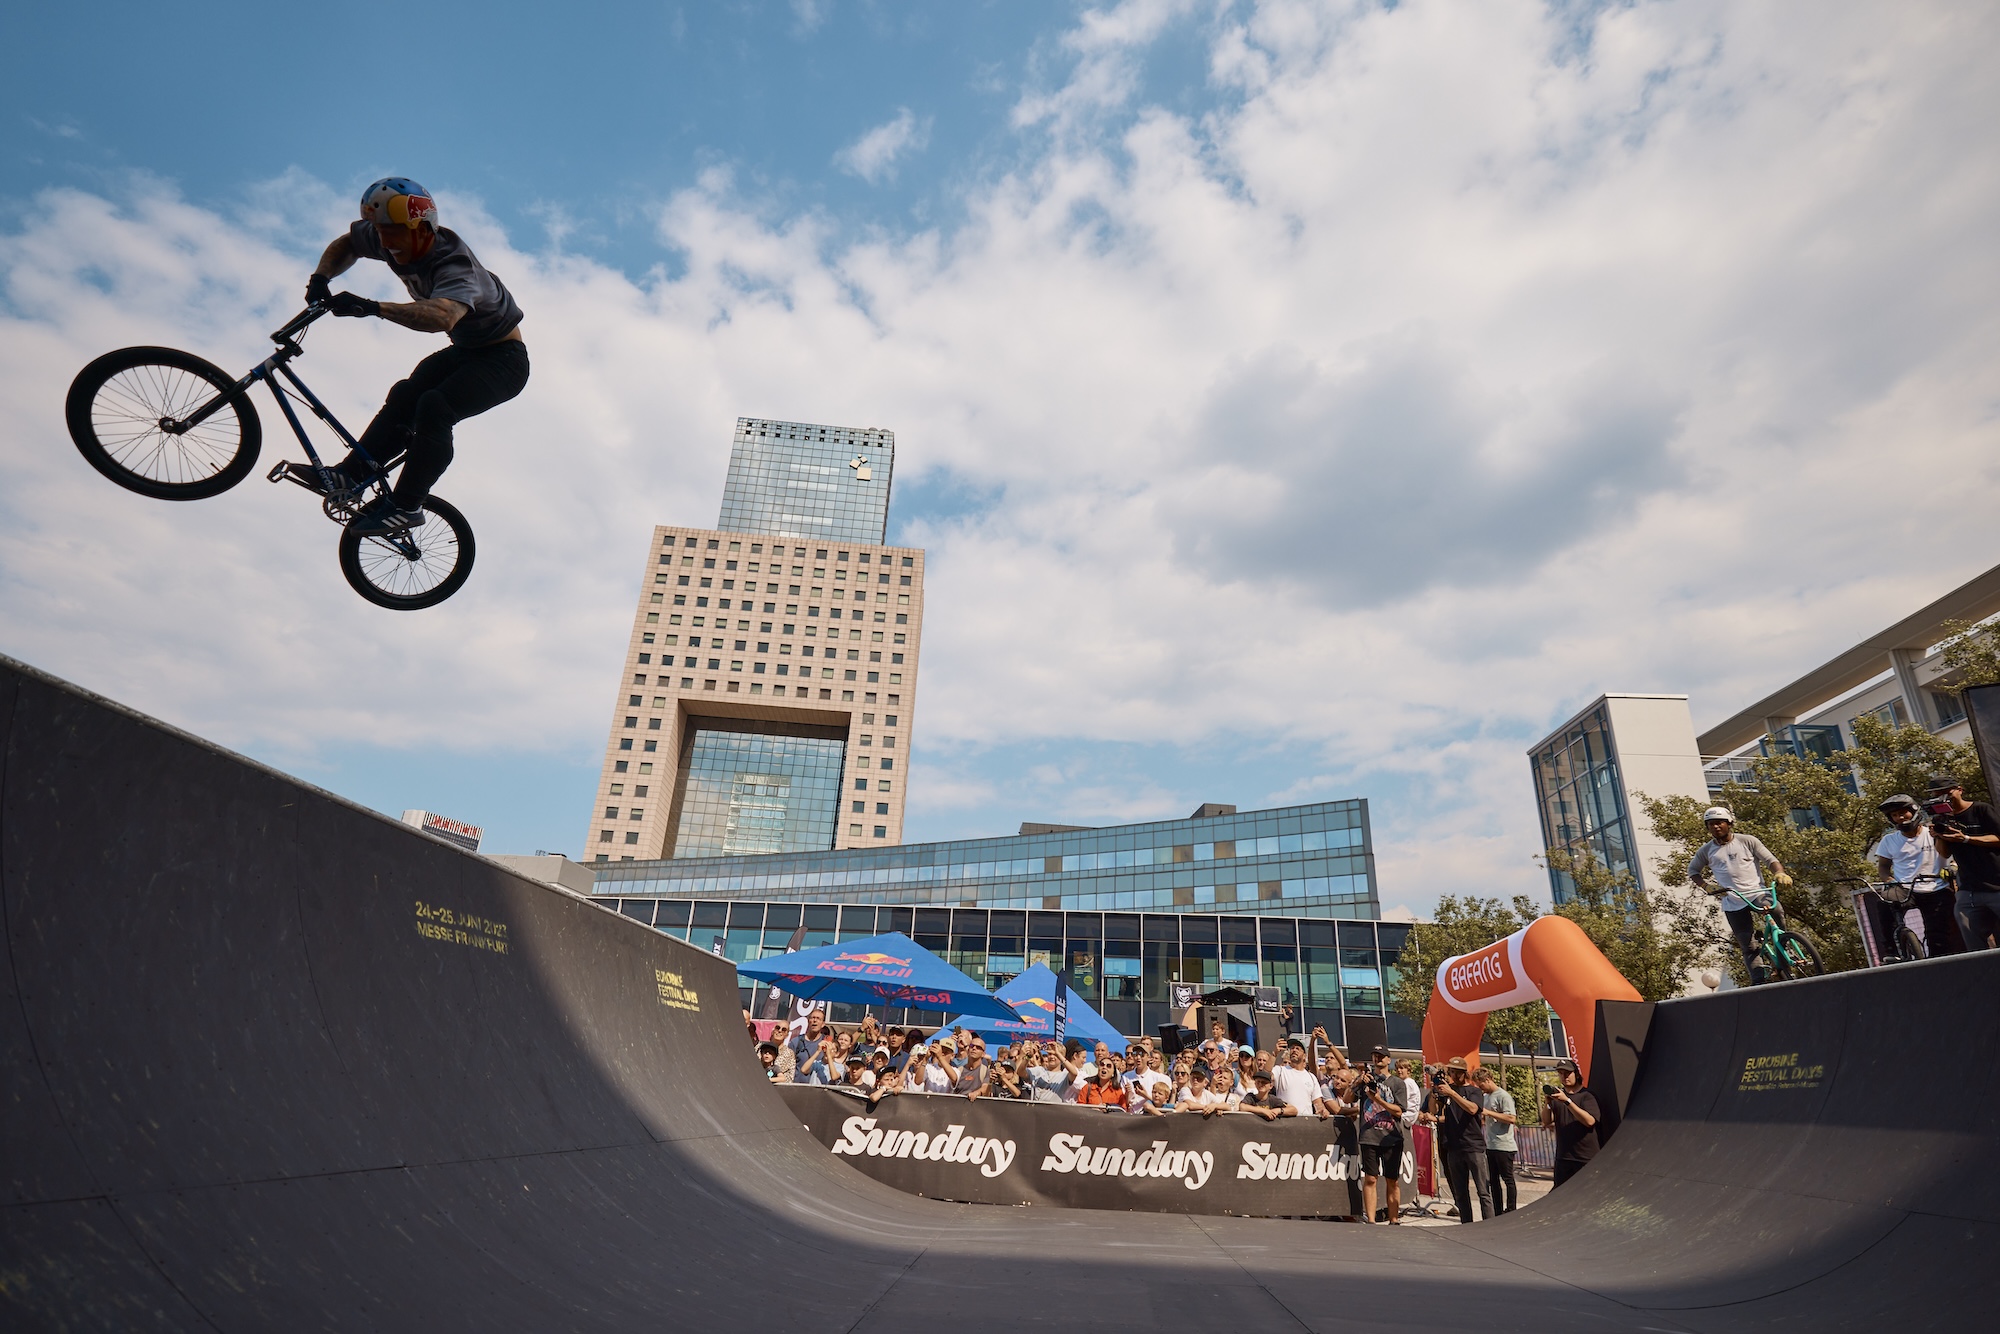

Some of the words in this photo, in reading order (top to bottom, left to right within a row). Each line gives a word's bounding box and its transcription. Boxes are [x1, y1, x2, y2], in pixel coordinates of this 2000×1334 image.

[416, 920, 454, 943] MESSE
[816, 960, 866, 973] Red
[865, 966, 914, 978] Bull
[1451, 951, 1503, 991] BAFANG
[994, 1020, 1021, 1029] Red
[1021, 1022, 1049, 1031] Bull
[1741, 1069, 1788, 1083] FESTIVAL
[1791, 1065, 1823, 1080] DAYS
[832, 1116, 1016, 1177] Sunday
[1041, 1132, 1214, 1191] Sunday
[1236, 1141, 1363, 1192] Sunda
